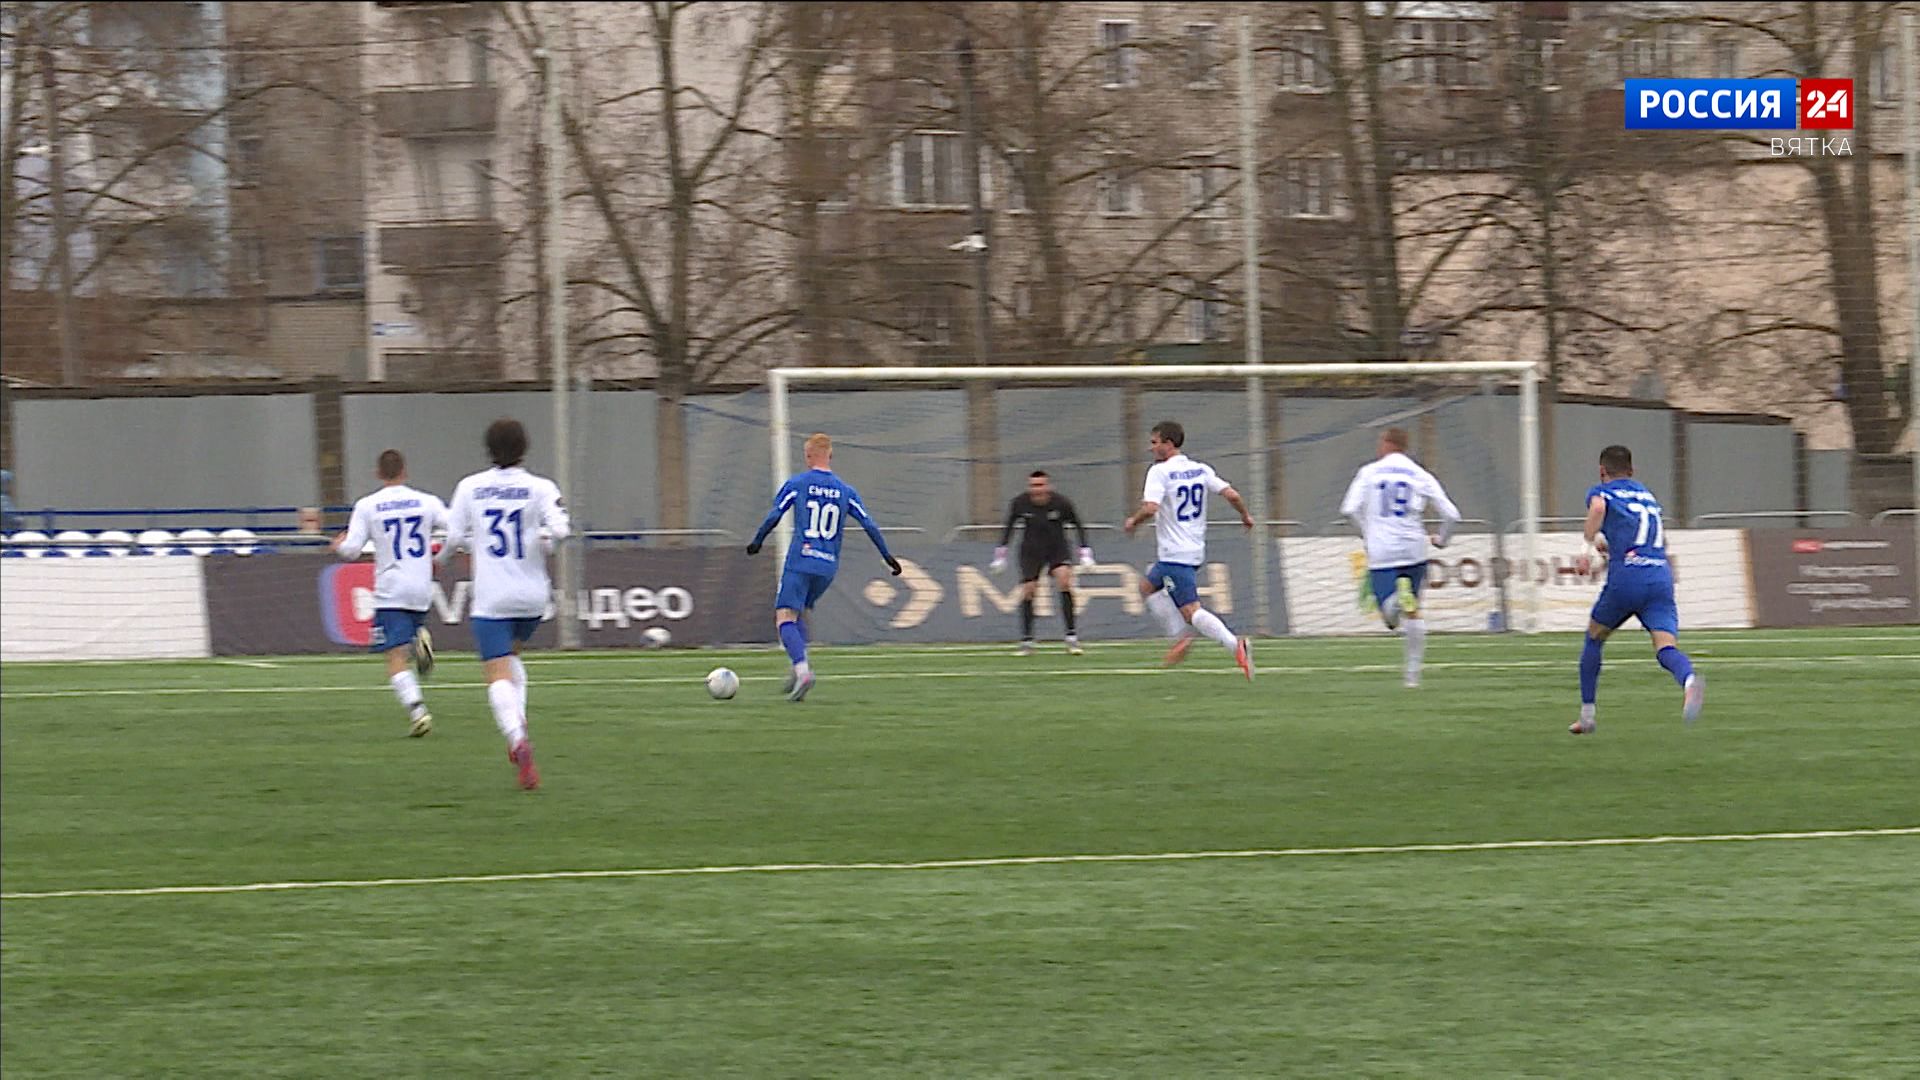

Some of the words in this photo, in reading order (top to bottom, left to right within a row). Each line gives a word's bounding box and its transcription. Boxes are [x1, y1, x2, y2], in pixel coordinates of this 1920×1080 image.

[804, 499, 840, 540] 10
[1176, 482, 1204, 521] 29
[1377, 480, 1413, 518] 19
[383, 515, 425, 560] 73
[482, 508, 526, 560] 31
[1627, 502, 1665, 548] 77
